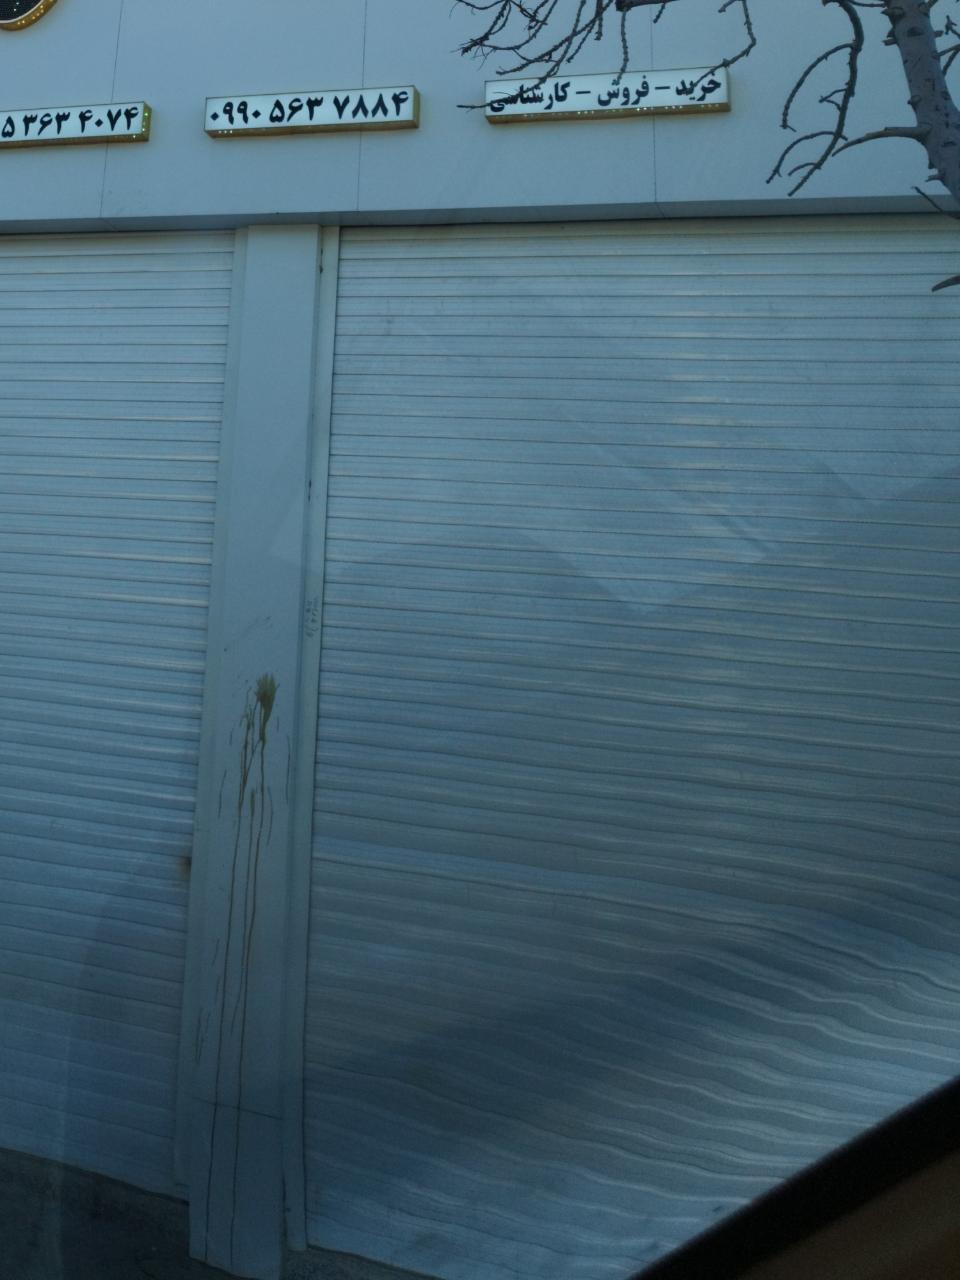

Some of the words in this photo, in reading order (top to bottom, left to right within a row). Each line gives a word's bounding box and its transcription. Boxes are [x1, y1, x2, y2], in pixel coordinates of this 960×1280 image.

[597, 75, 650, 106] فروش
[675, 73, 722, 101] خرید
[23, 112, 71, 136] ۳۶۳
[78, 106, 139, 133] ۴۰۷۴
[210, 101, 261, 125] ۰۹۹۰
[269, 97, 324, 123] ۵۶۳
[333, 91, 409, 119] ۷۸۸۴
